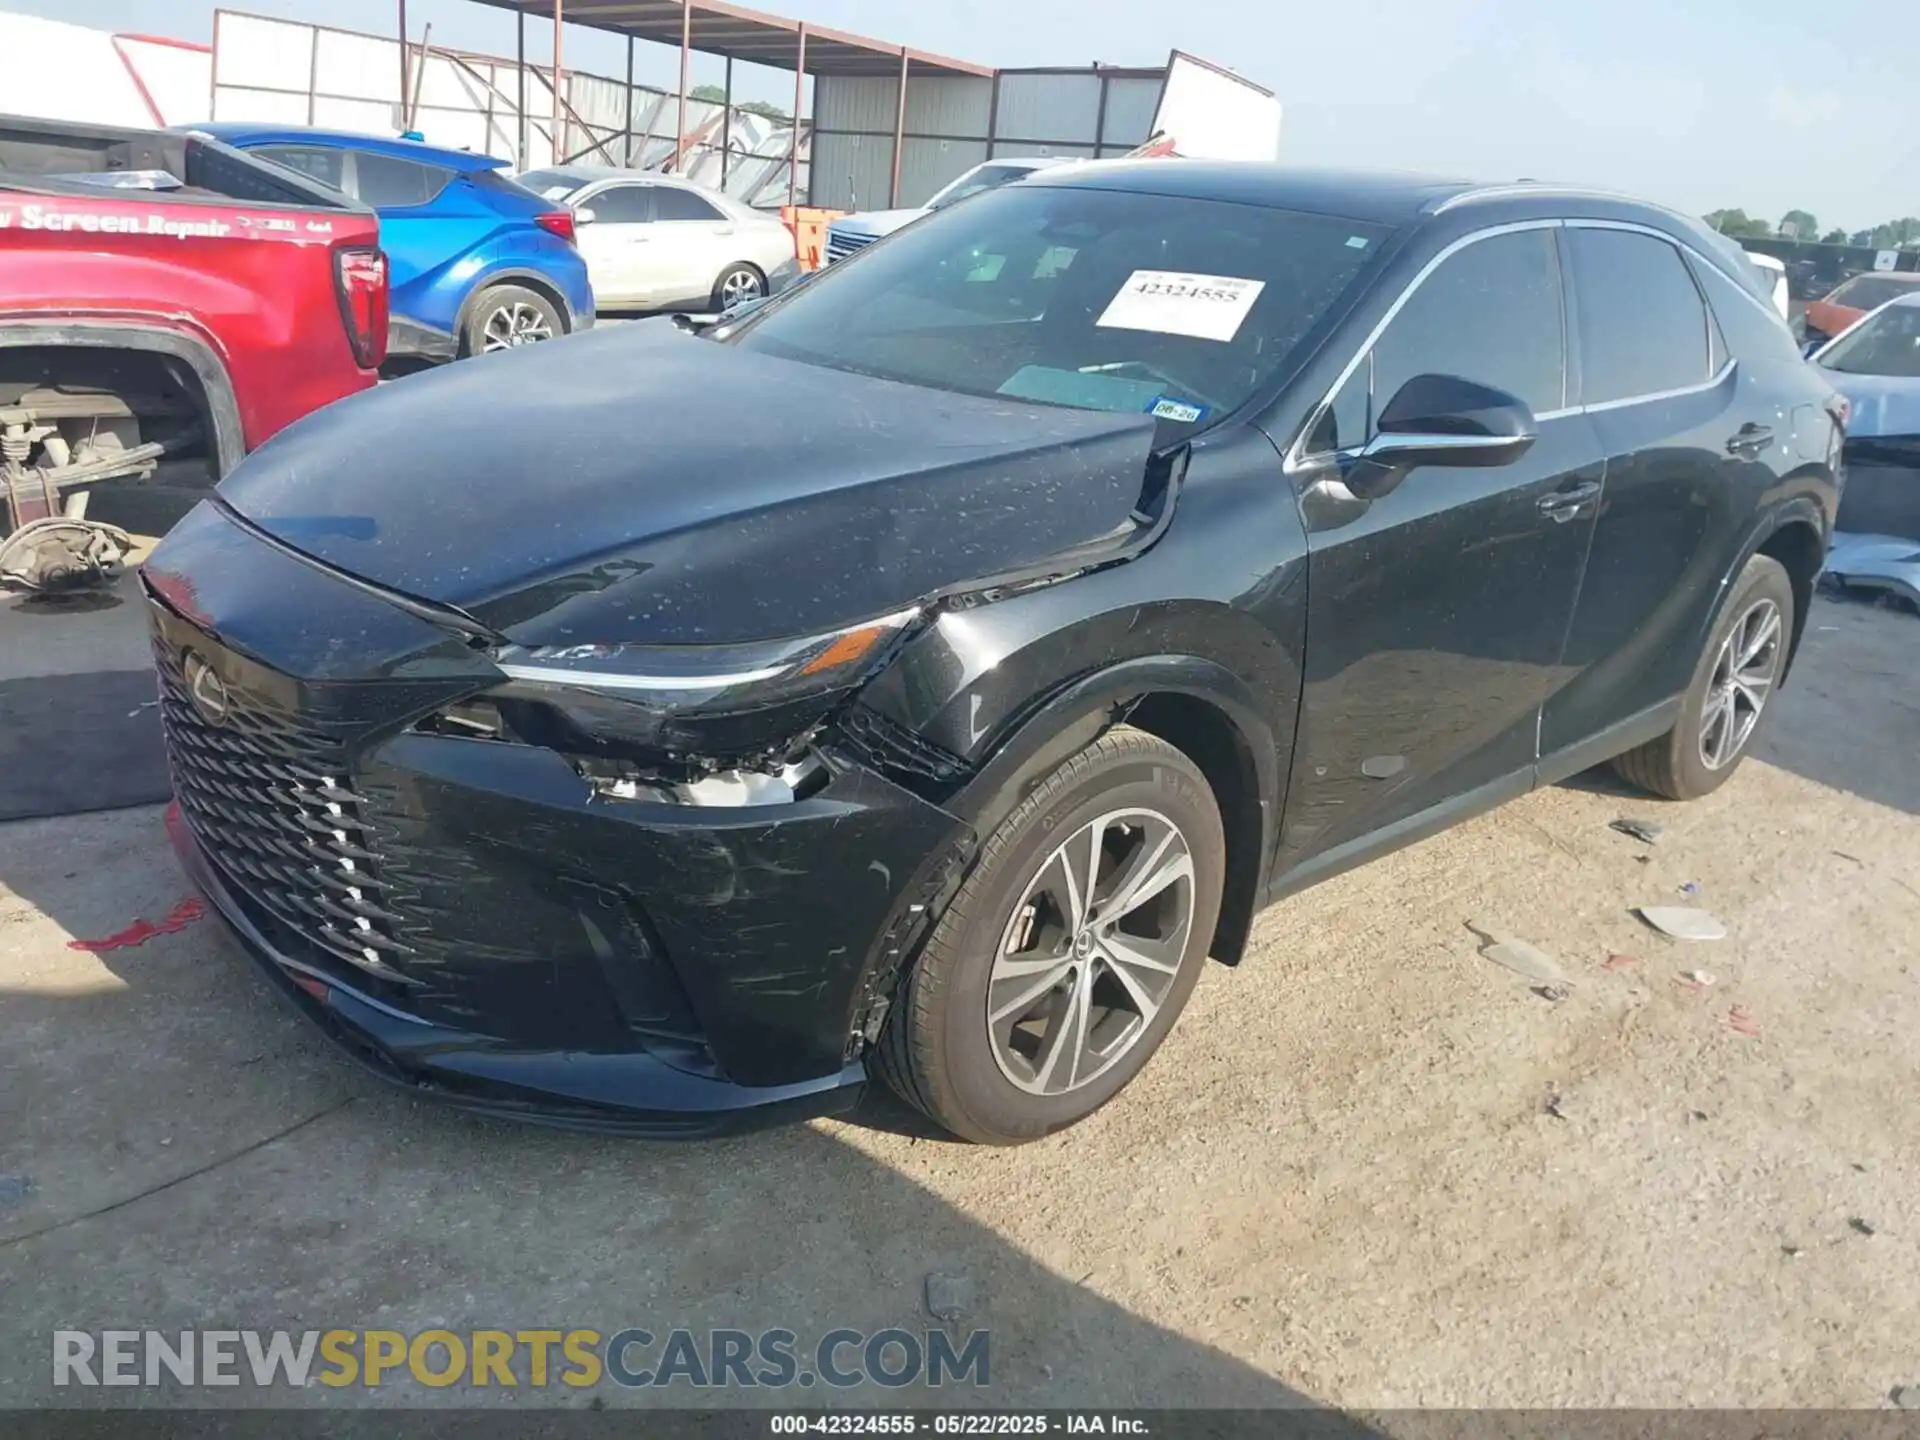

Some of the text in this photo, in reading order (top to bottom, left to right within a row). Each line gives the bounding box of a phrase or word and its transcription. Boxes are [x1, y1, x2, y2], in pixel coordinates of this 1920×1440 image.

[21, 204, 139, 233] Screen
[147, 214, 230, 239] Repair
[1133, 282, 1241, 302] 42324555
